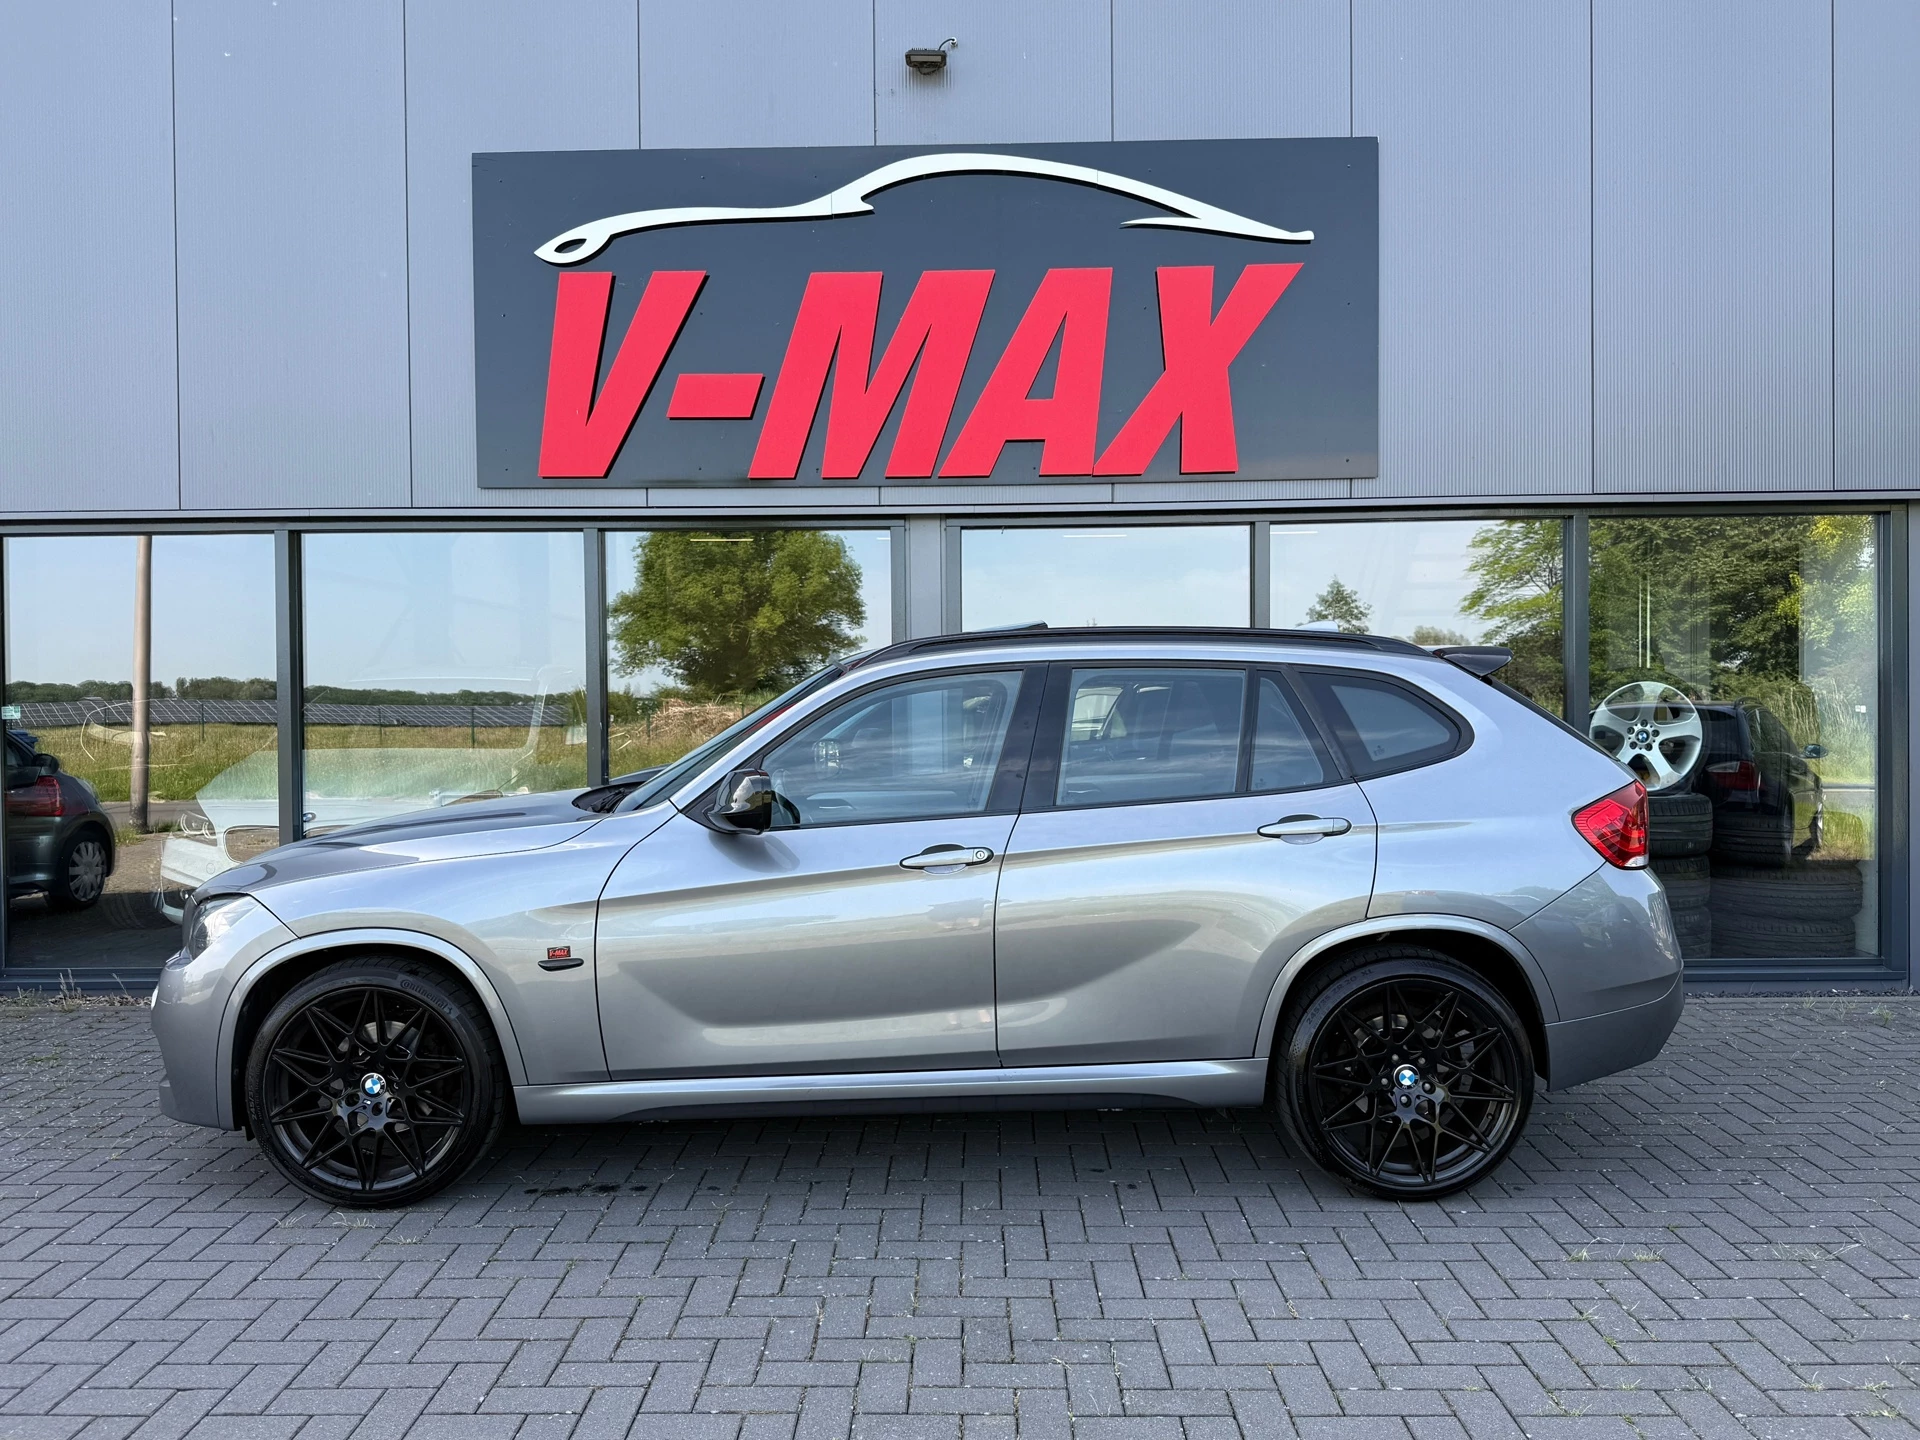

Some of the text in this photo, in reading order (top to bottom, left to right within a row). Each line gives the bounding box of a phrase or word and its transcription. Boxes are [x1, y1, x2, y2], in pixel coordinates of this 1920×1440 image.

[537, 262, 1304, 480] V-MAX
[549, 949, 568, 957] V-MAX
[400, 979, 448, 1009] Continental
